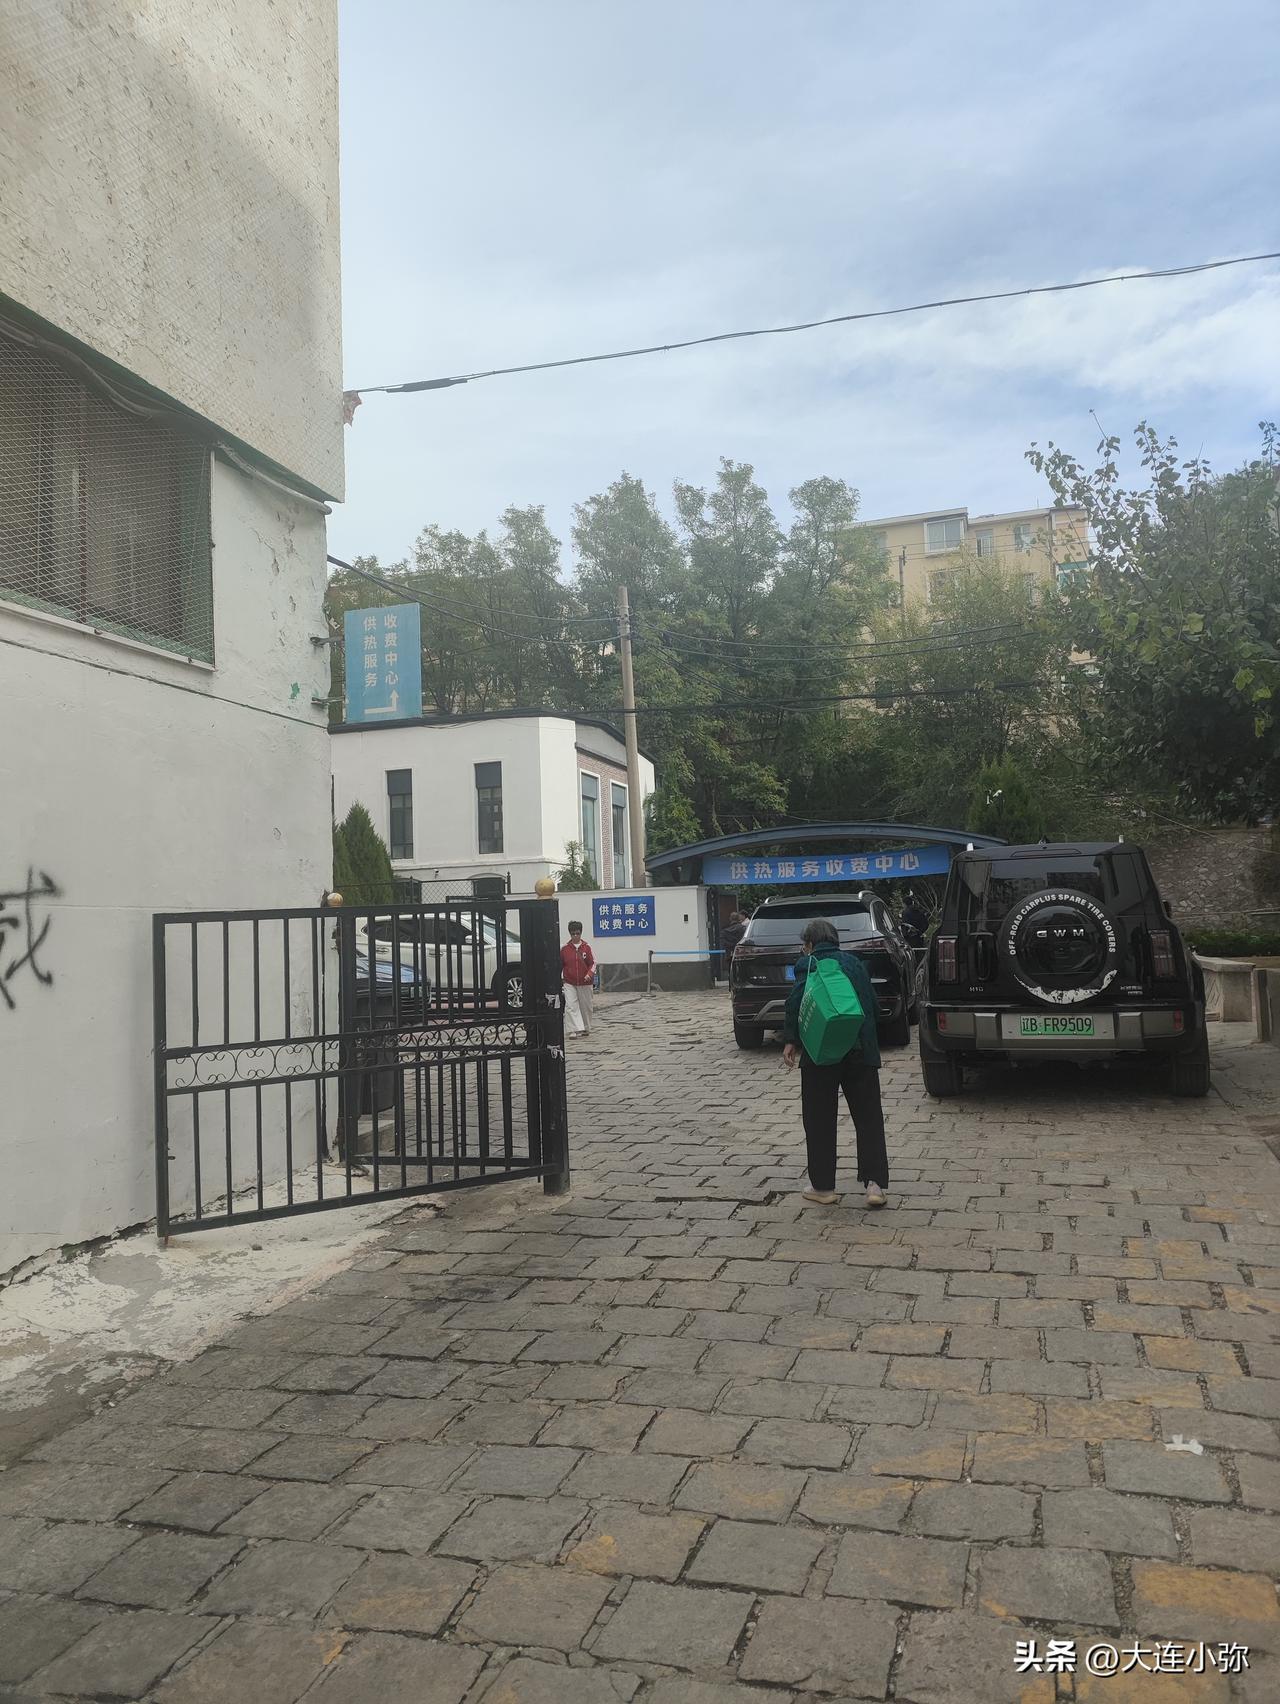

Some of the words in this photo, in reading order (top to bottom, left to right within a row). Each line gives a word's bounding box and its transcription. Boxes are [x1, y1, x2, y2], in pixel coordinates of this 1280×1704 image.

[363, 615, 378, 688] 供热服务
[384, 613, 399, 685] 收费中心
[730, 852, 920, 880] 供热服务收费中心
[599, 903, 648, 916] 供热服务
[599, 918, 649, 930] 收费中心
[1008, 914, 1023, 956] OFF-ROAD
[1020, 894, 1057, 915] CARPLUS
[1058, 894, 1087, 906] SPARE
[1086, 902, 1105, 920] TIRE
[1102, 919, 1116, 953] COVERS
